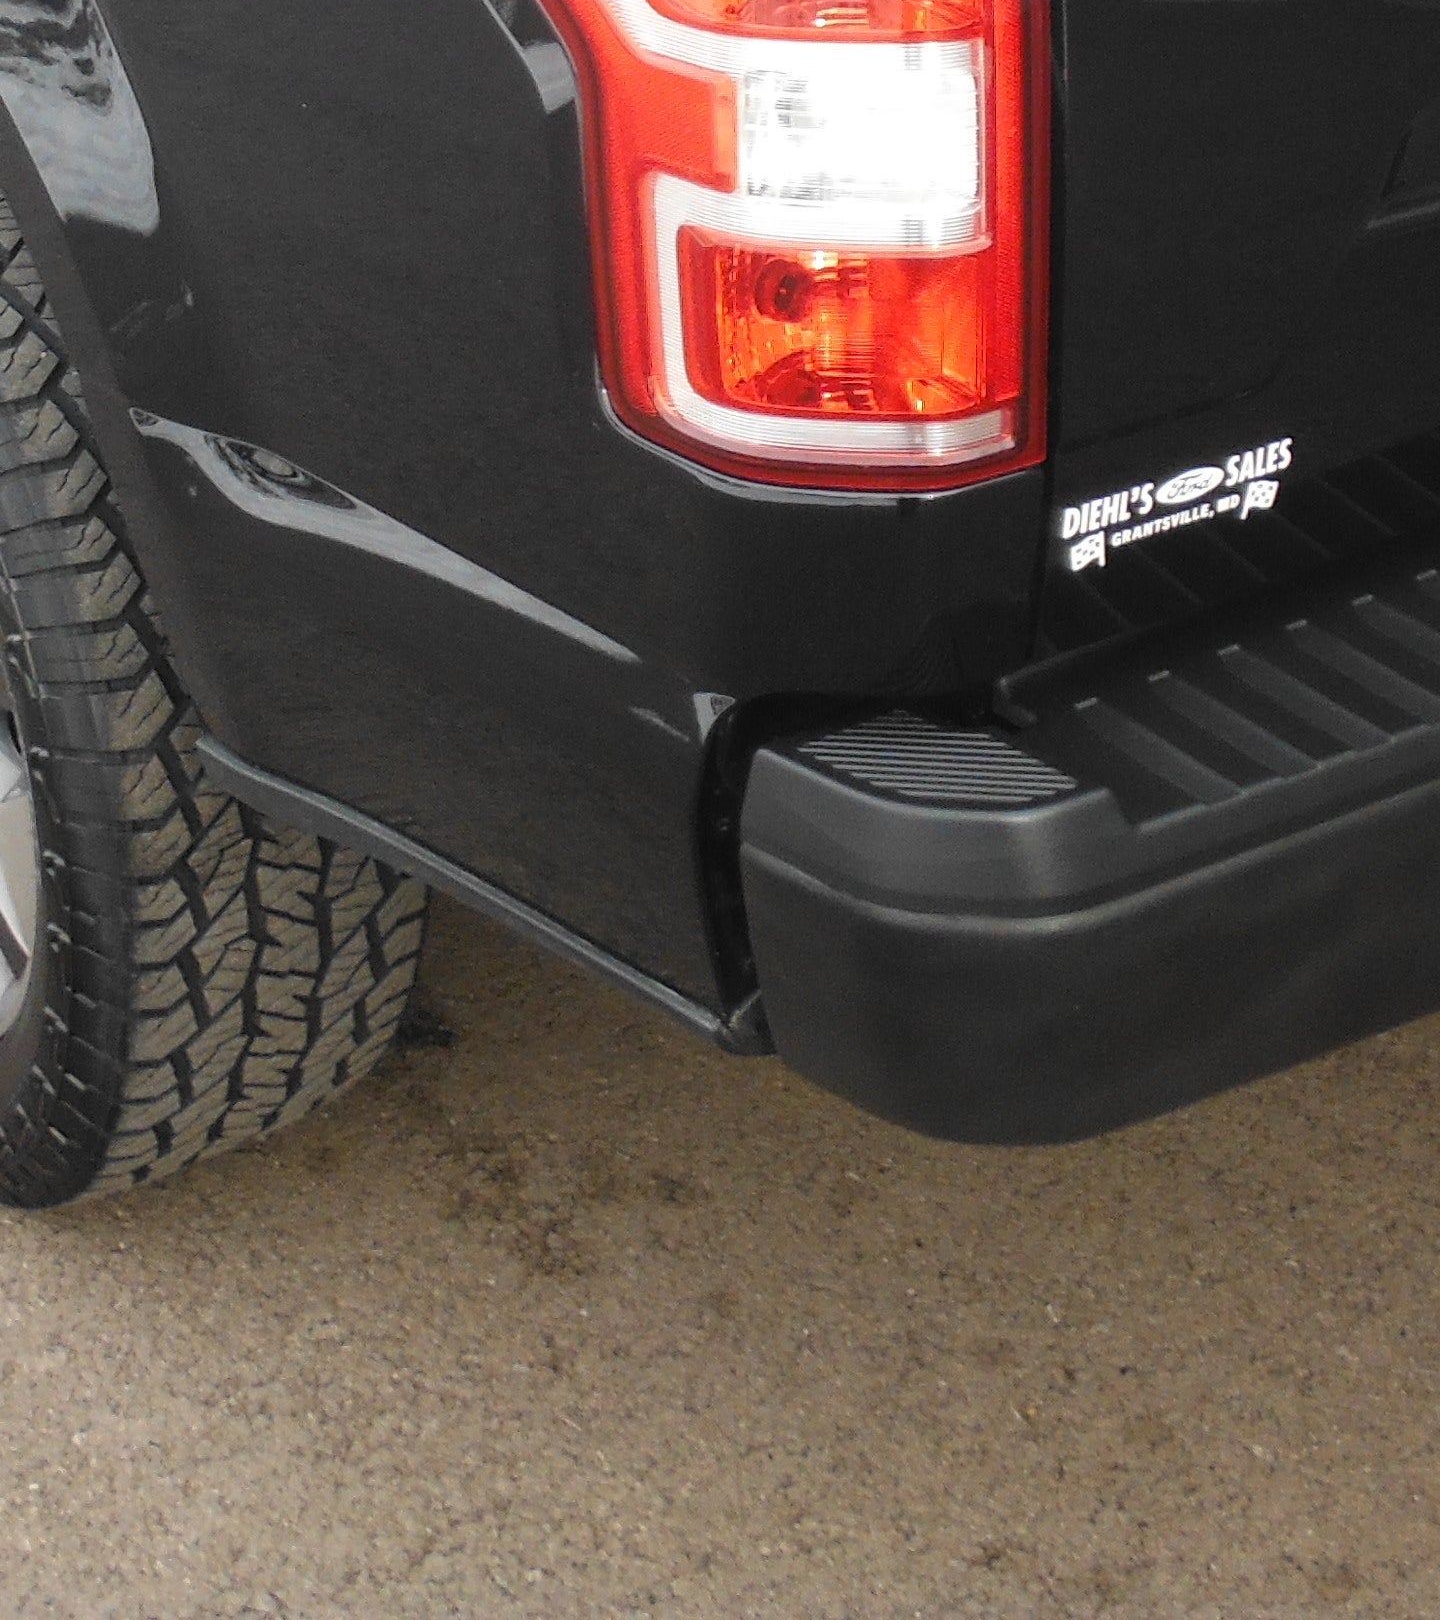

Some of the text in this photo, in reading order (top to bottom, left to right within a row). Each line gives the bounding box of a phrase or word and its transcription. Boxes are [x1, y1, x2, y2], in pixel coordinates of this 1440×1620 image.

[1062, 482, 1155, 540] DIEHL'S
[1225, 437, 1293, 487] SALES
[1111, 503, 1216, 547] GRANTSVILLE,
